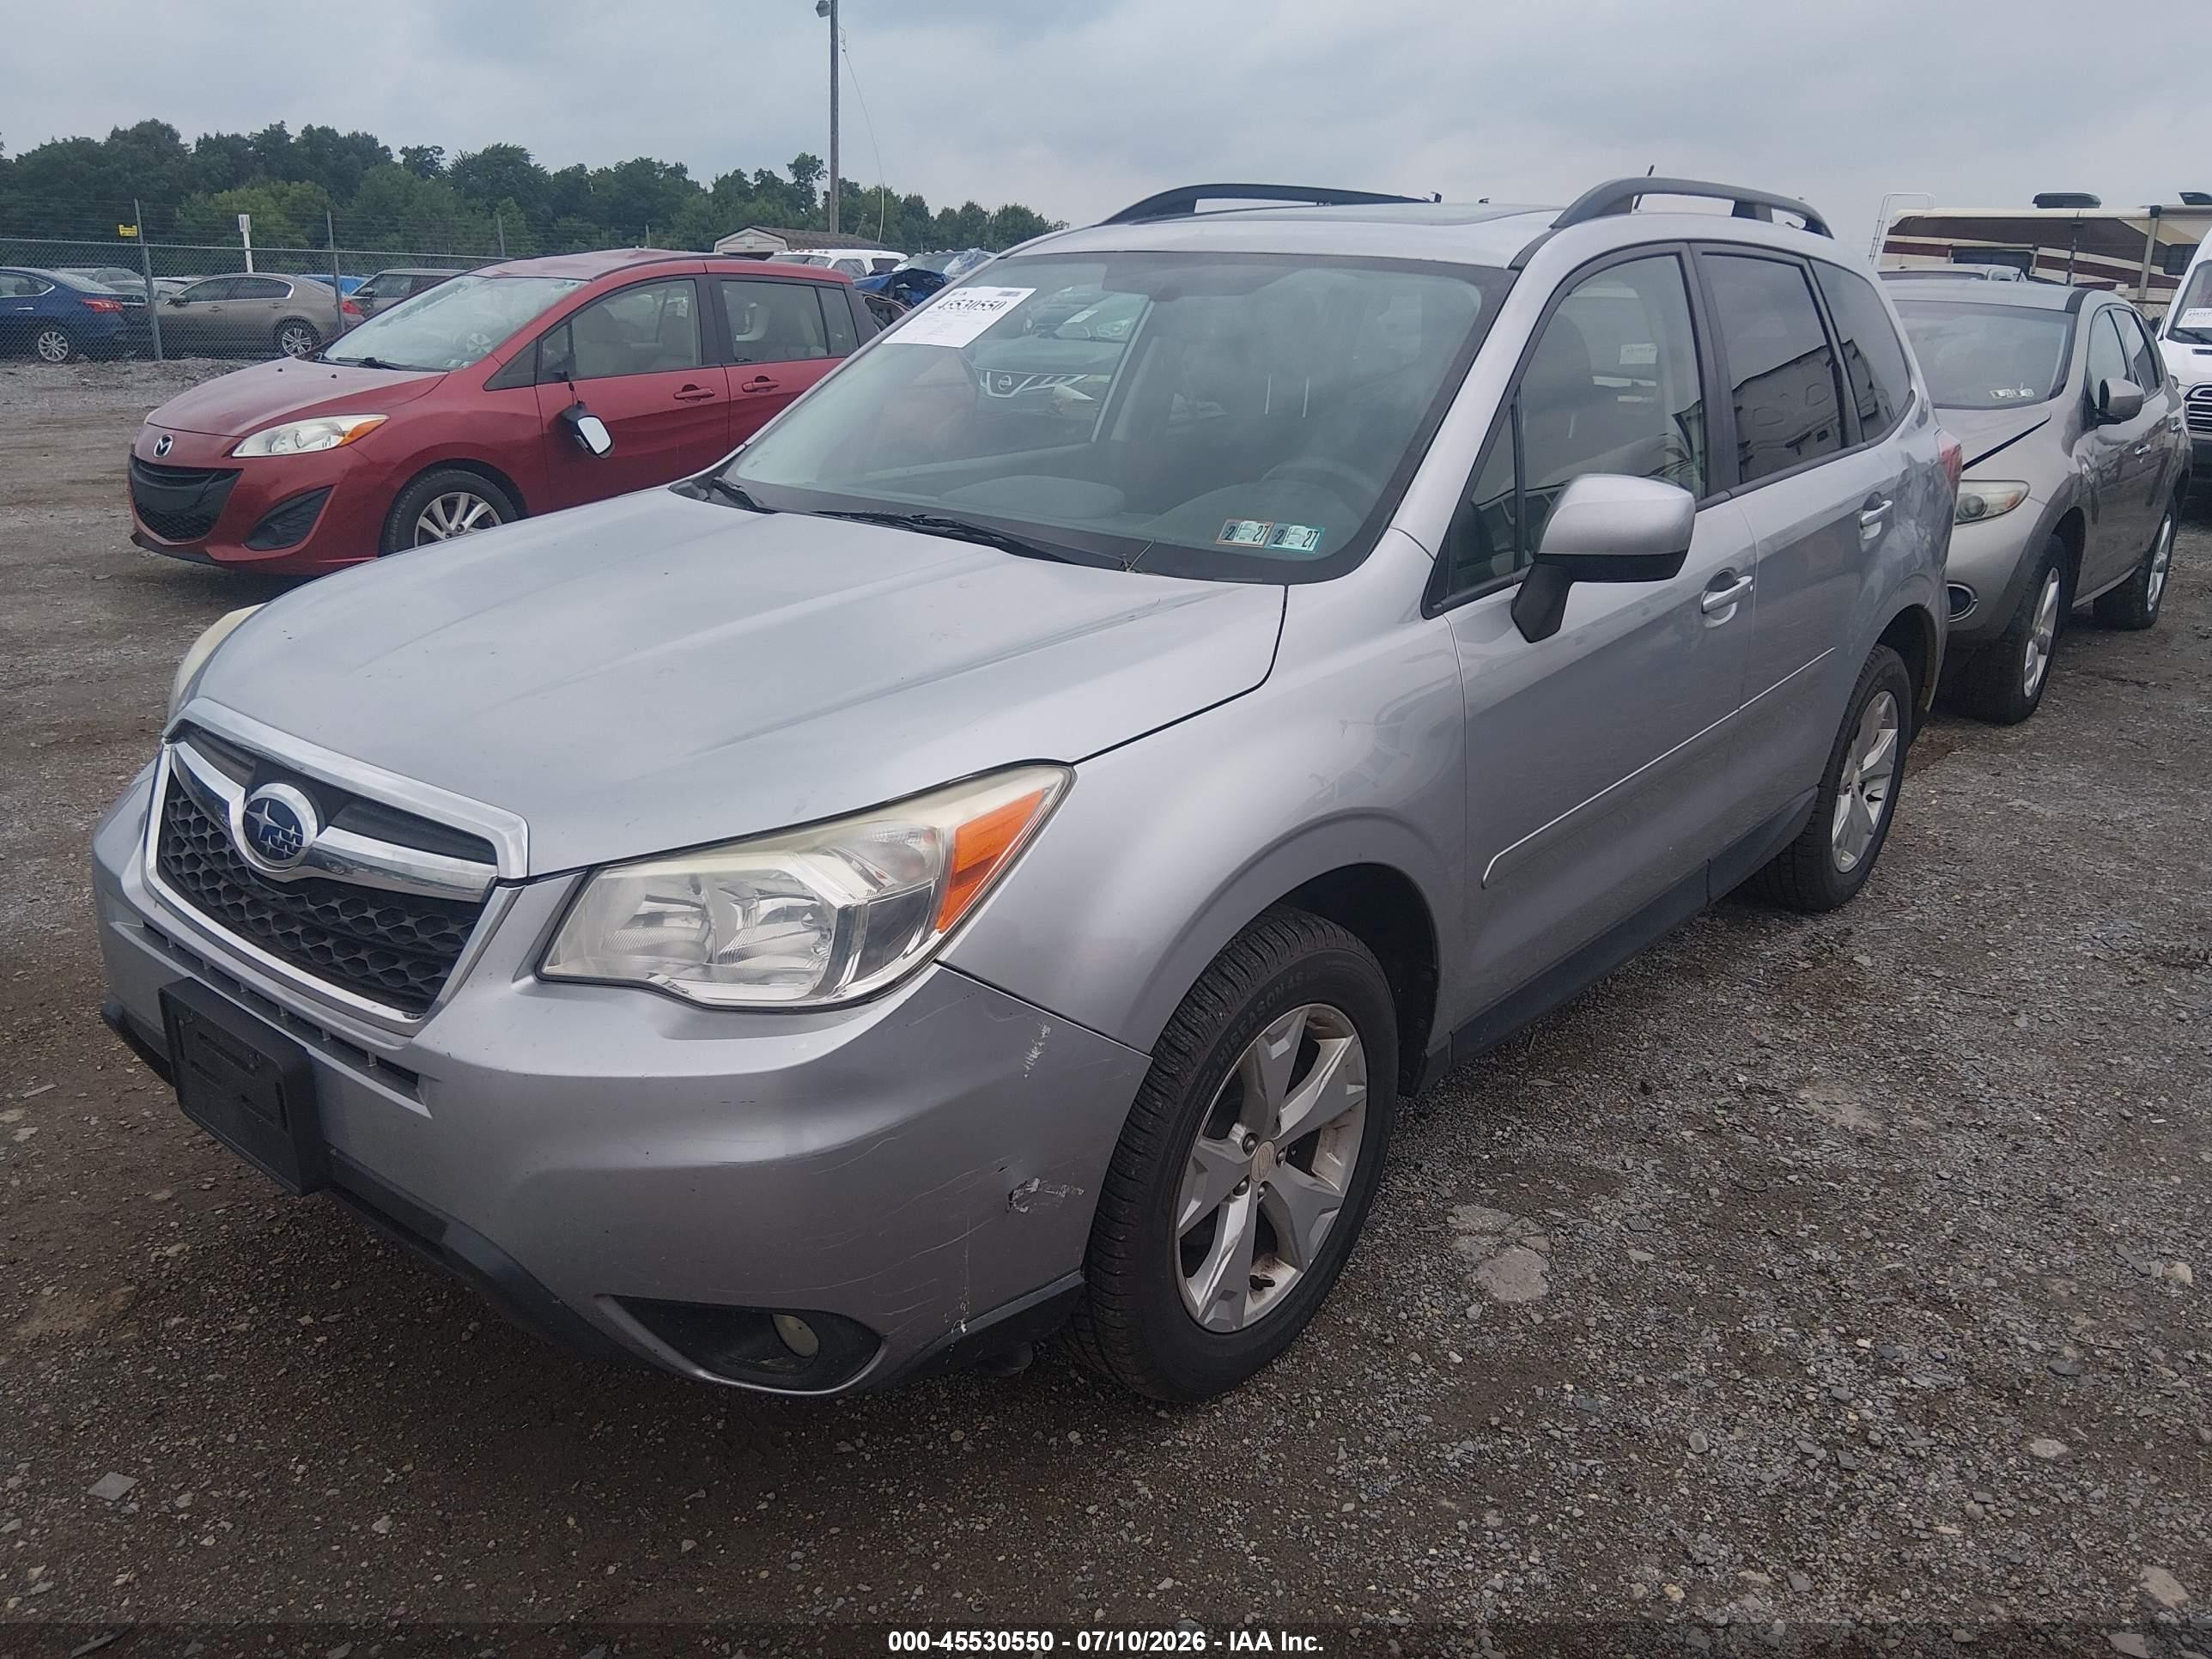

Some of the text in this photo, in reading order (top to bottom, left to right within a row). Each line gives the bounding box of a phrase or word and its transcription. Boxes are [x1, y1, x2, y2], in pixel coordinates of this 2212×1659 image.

[939, 300, 1006, 311] 45530550
[1253, 526, 1269, 543] 27
[1302, 531, 1319, 550] 27
